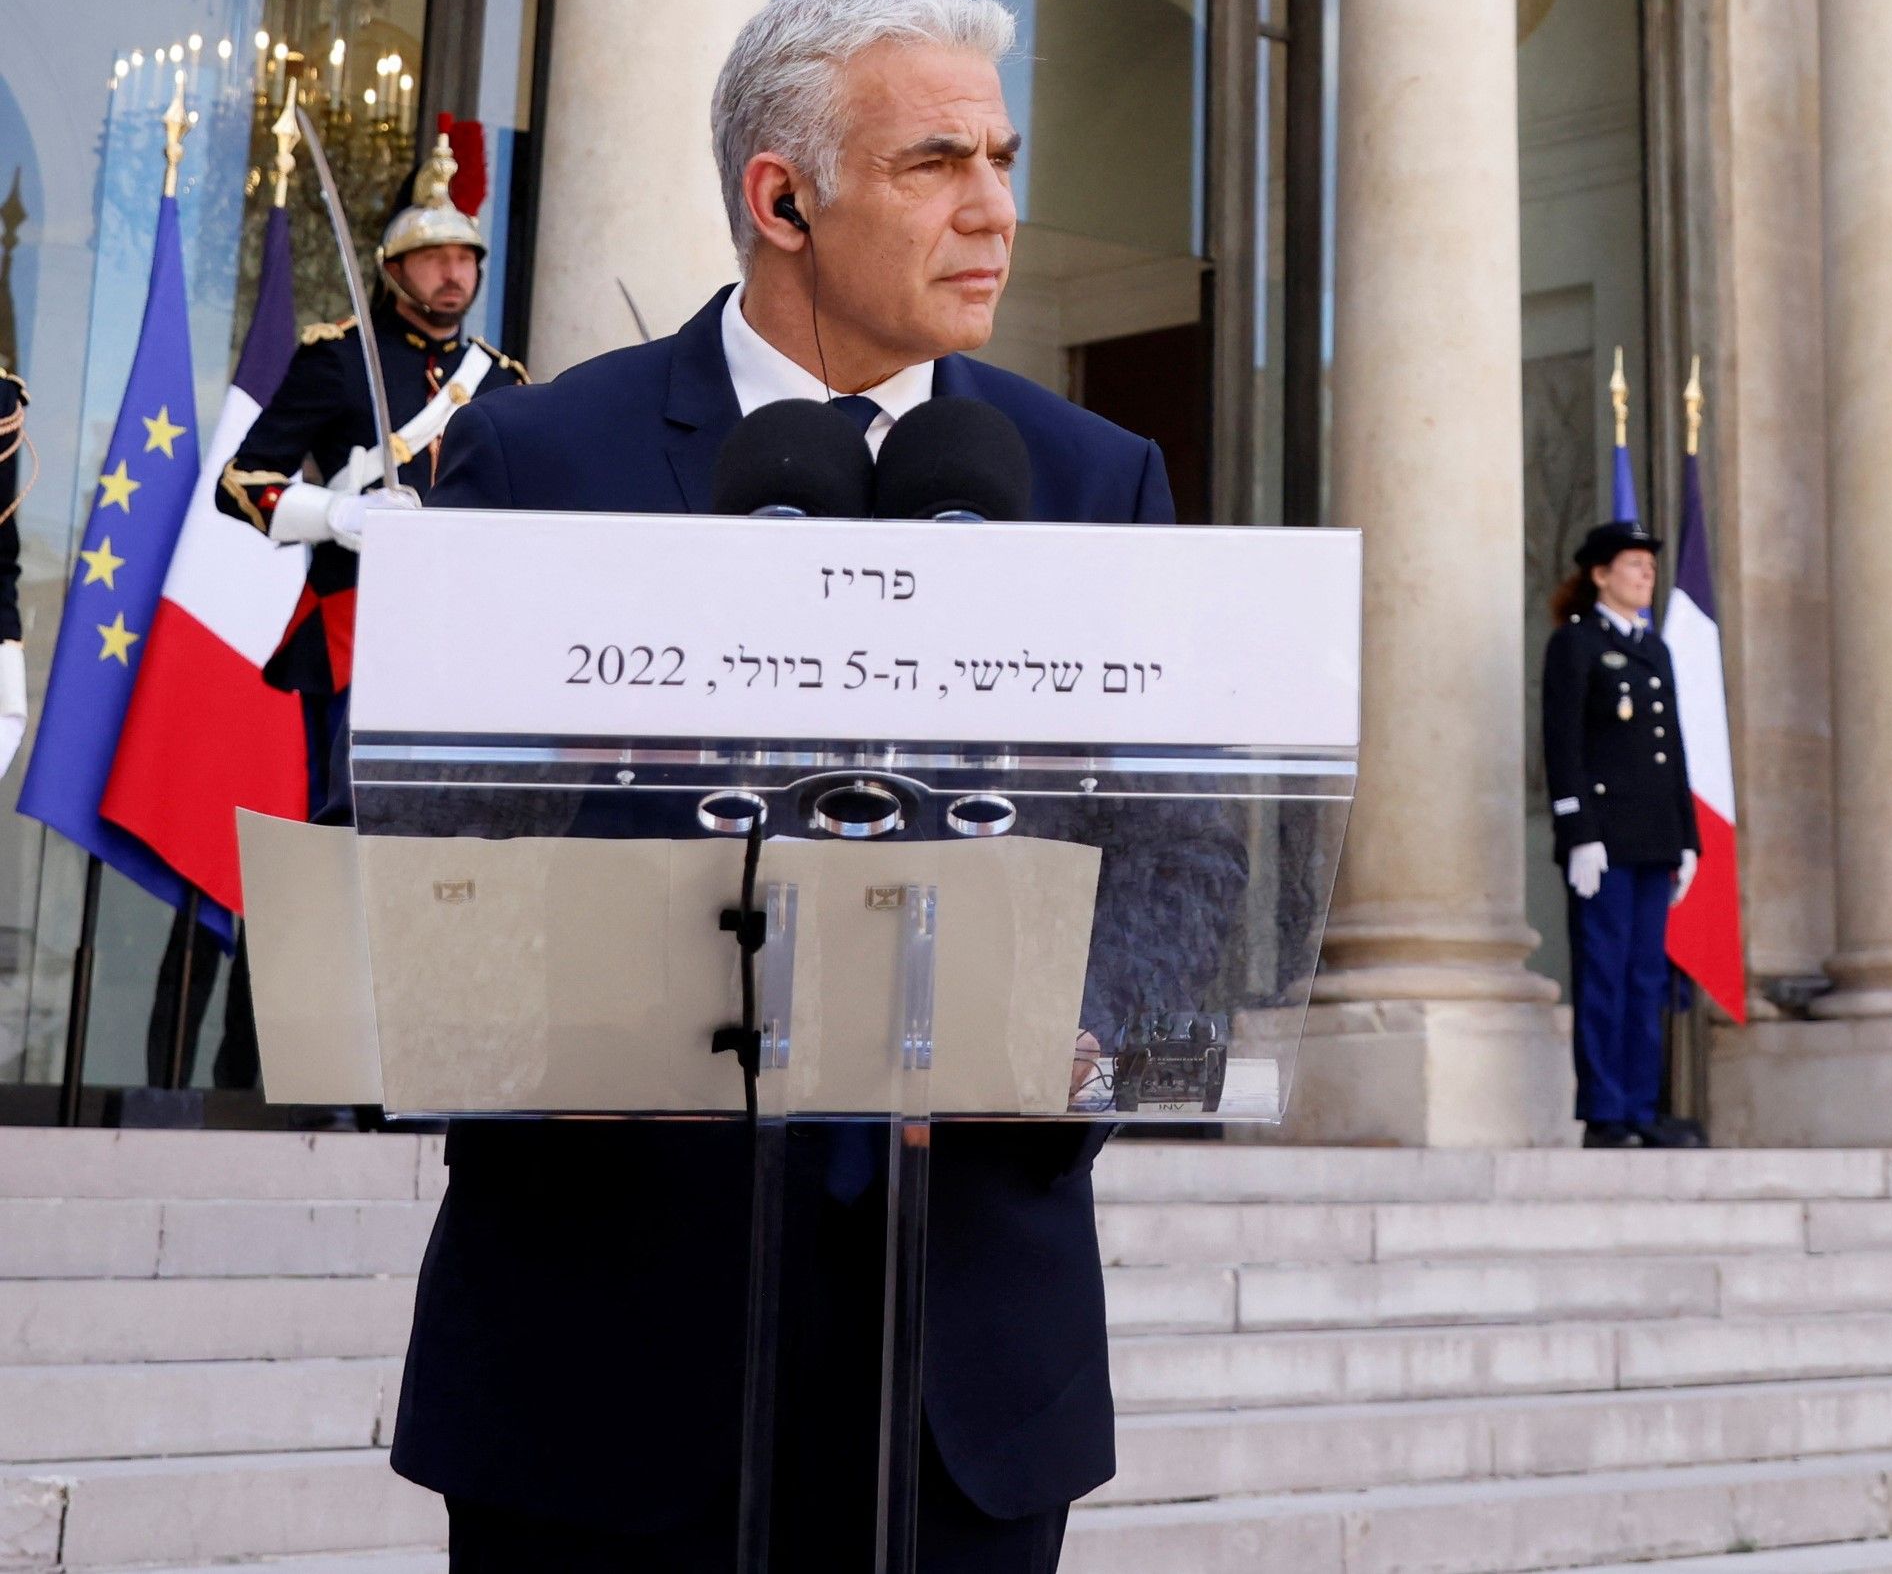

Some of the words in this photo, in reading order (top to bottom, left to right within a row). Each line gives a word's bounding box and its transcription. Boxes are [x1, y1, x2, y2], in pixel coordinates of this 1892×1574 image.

[820, 567, 917, 601] פריז
[565, 644, 686, 686] 2022
[706, 644, 825, 696] ביולי,
[843, 650, 920, 691] ה-5
[938, 649, 1085, 699] שלישי,
[1102, 661, 1164, 694] יום
